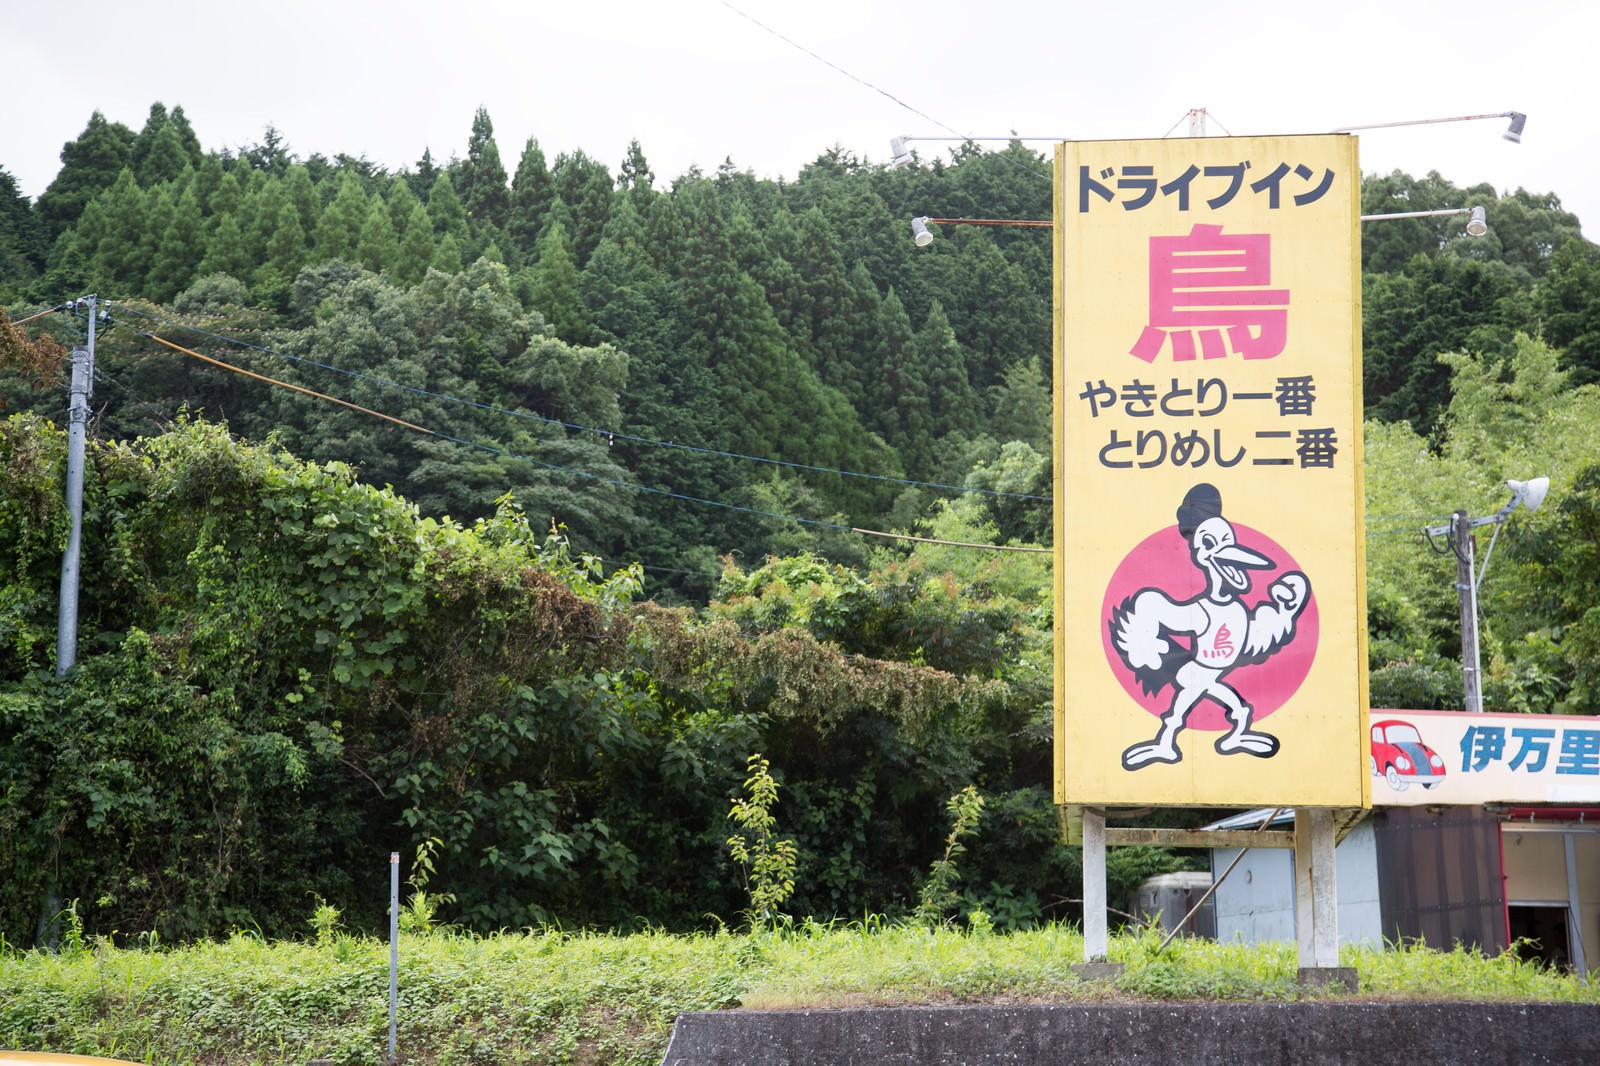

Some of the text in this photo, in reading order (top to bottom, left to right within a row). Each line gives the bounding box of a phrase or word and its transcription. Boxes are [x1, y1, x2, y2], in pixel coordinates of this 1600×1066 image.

[1079, 160, 1335, 213] ドライブイン
[1129, 223, 1290, 364] 鳥
[1079, 375, 1316, 417] やきとり一番
[1099, 428, 1338, 469] とりめし二番
[1460, 725, 1600, 776] 伊万里
